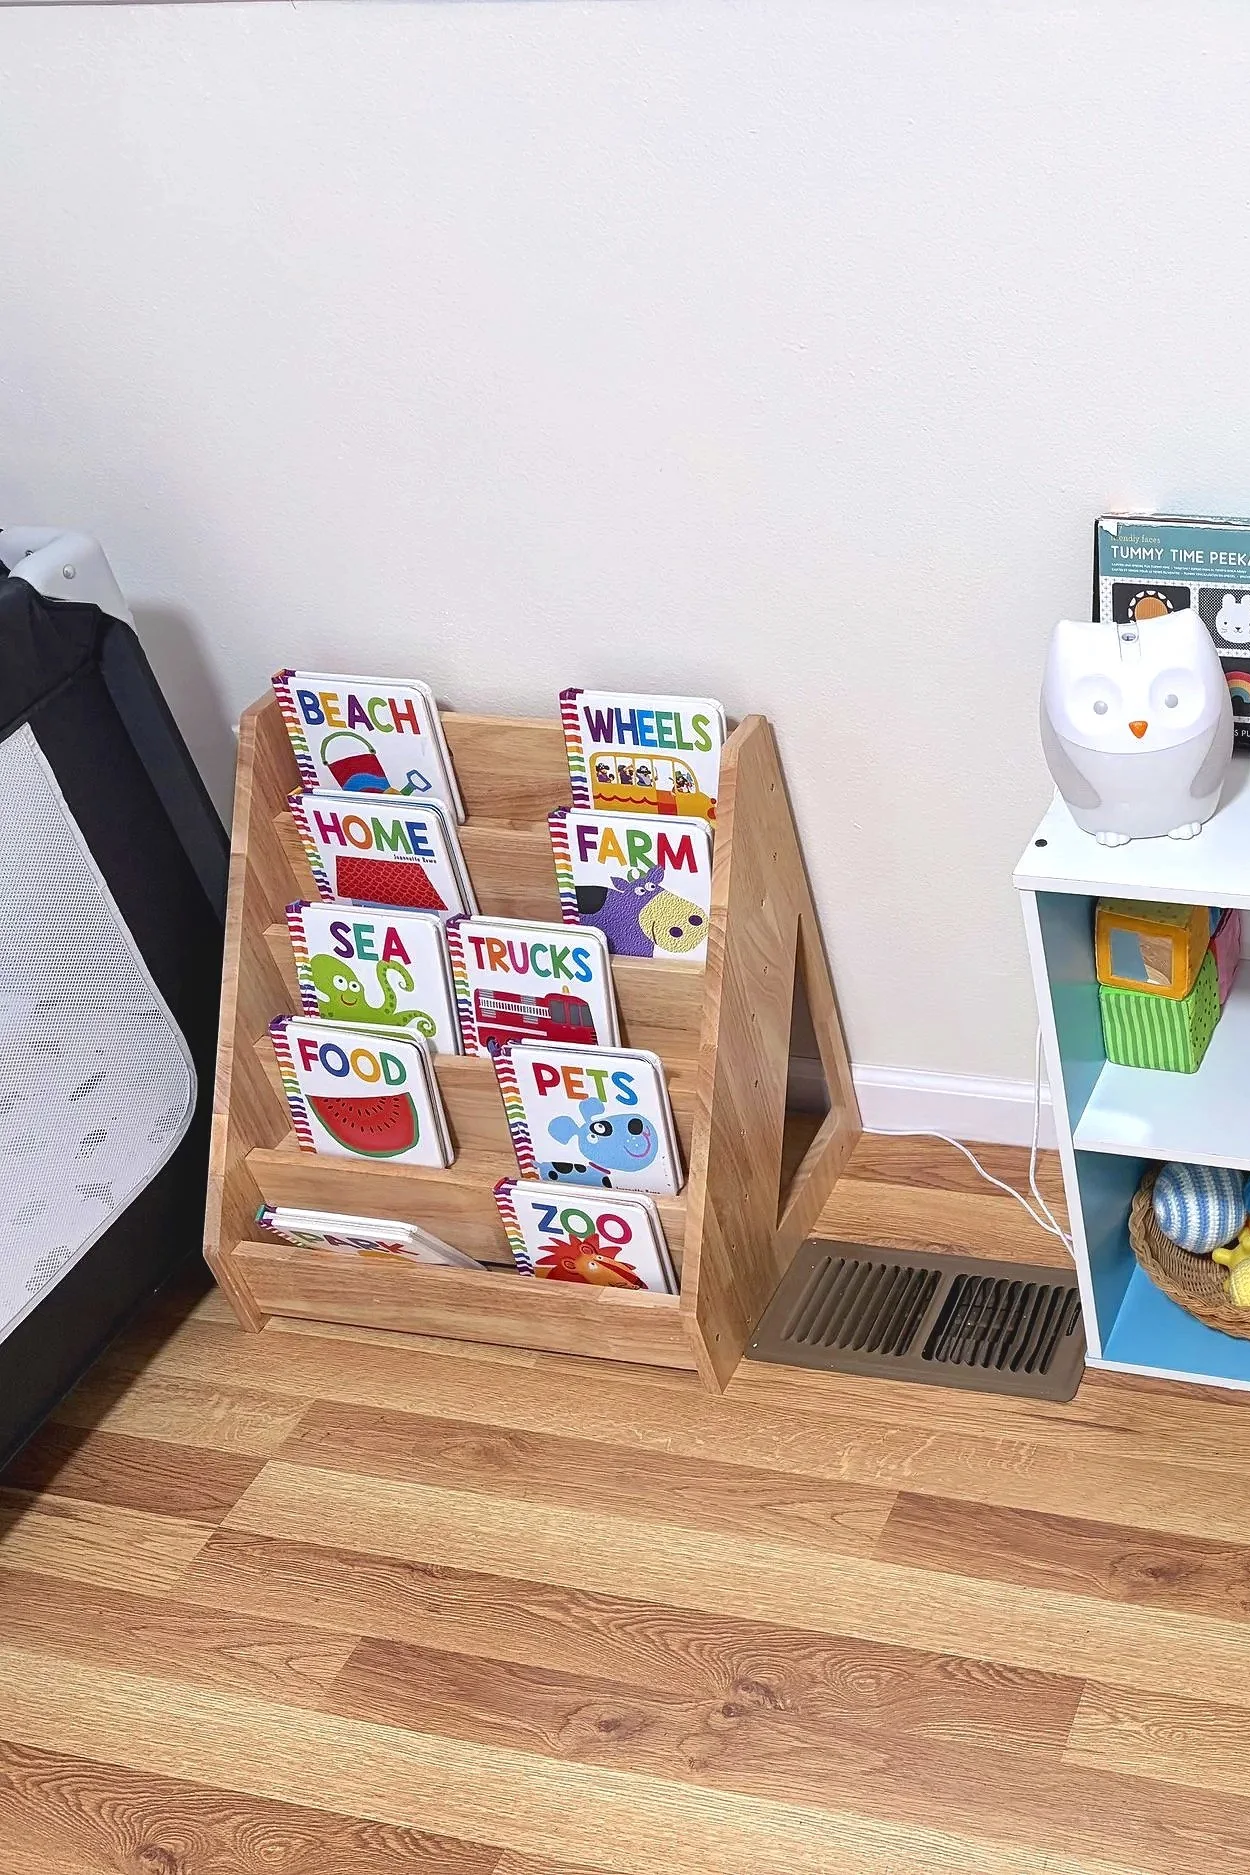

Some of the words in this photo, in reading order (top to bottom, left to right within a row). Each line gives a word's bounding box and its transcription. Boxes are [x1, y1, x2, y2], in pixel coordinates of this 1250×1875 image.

[1111, 545, 1164, 561] TUMMY
[1170, 549, 1204, 564] TIME
[296, 688, 421, 735] BEACH
[583, 705, 713, 752] WHEELS
[312, 809, 435, 857] HOME
[576, 825, 698, 874] FARM
[329, 920, 412, 966] SEA
[468, 935, 593, 982] TRUCKS
[297, 1038, 407, 1086] FOOD
[532, 1062, 639, 1106] PETS
[290, 1230, 420, 1255] PARK
[531, 1202, 632, 1244] ZOO
